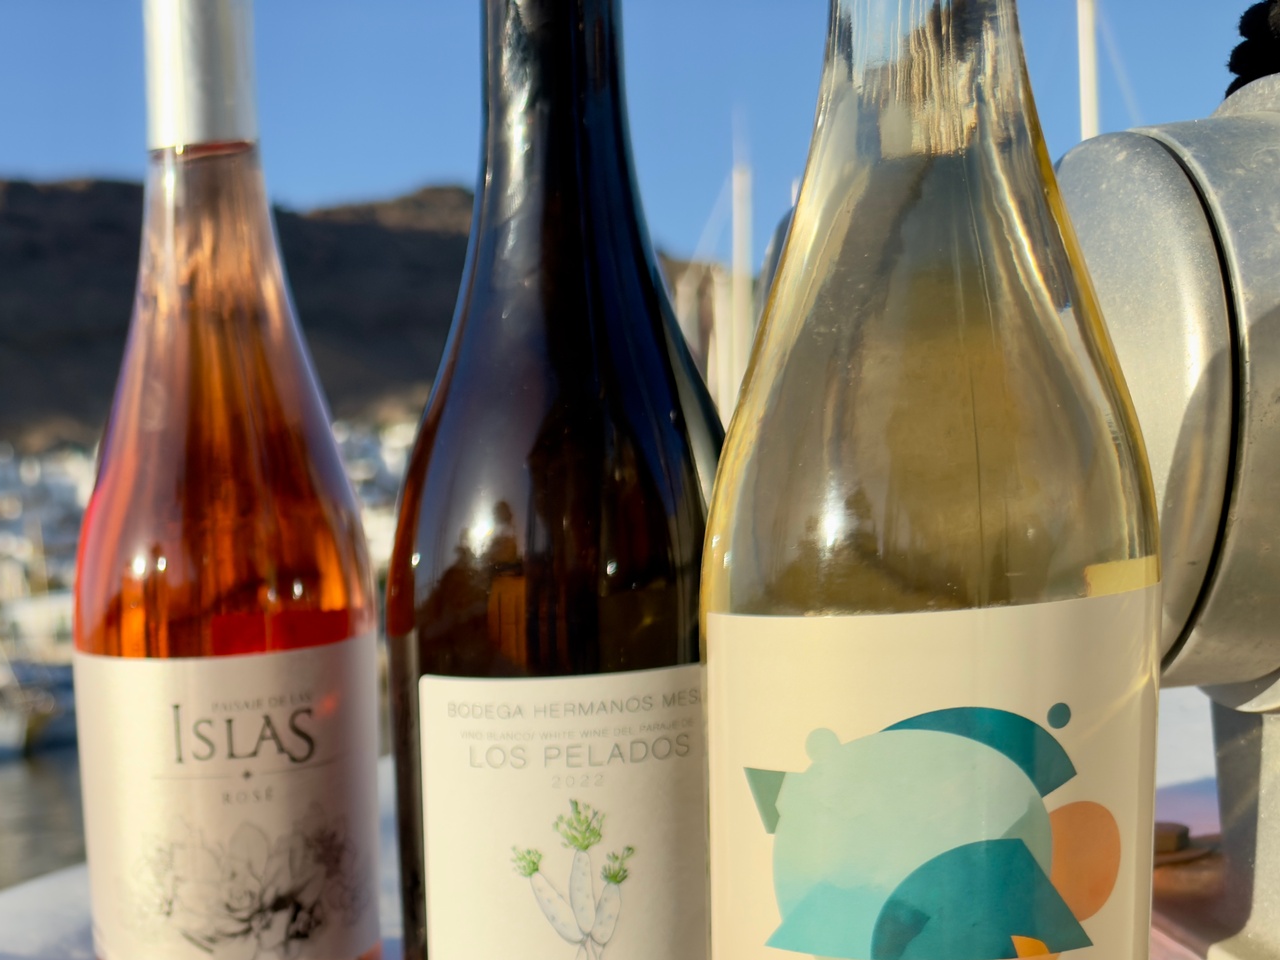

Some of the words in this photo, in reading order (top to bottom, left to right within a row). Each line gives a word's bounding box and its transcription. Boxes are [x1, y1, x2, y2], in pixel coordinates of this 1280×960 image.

[447, 701, 524, 720] BODEGA
[533, 695, 654, 719] HERMANOS
[172, 704, 316, 764] ISLAS
[538, 729, 576, 741] WHITE
[580, 727, 610, 739] WINE
[613, 726, 633, 737] DEL
[469, 745, 528, 770] LOS
[543, 733, 691, 769] PELADOS
[551, 774, 605, 789] 2022
[222, 785, 274, 805] ROSÉ
